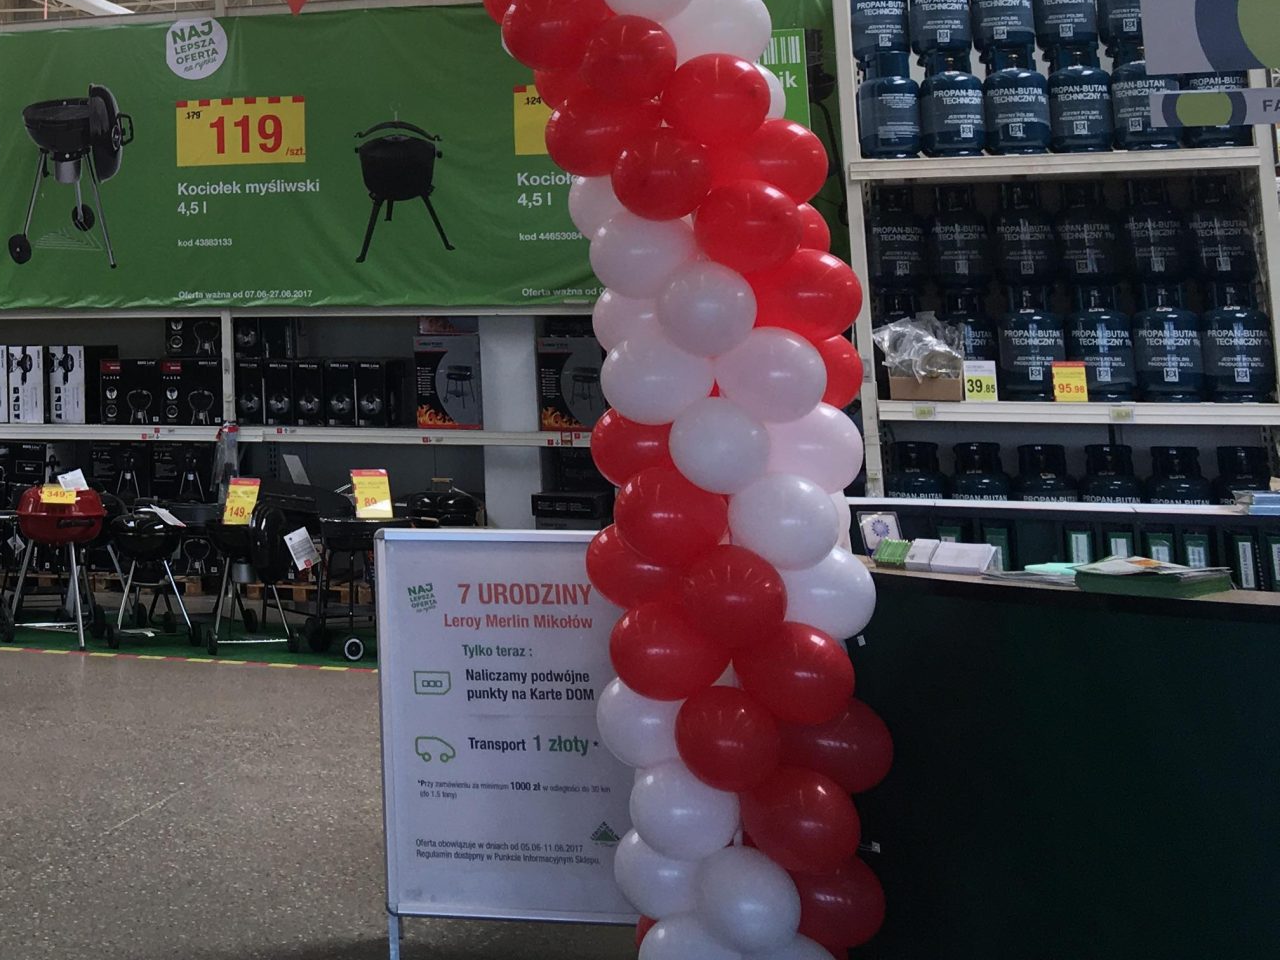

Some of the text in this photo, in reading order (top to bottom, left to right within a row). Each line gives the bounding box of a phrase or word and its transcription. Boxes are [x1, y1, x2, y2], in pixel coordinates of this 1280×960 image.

[922, 3, 962, 11] TECHNICZNY
[171, 20, 213, 45] NAJ
[174, 37, 216, 55] LEPSZA
[176, 47, 218, 65] OFERTA
[994, 96, 1035, 104] TECHNICZNY
[1058, 93, 1100, 101] TECHNICZNY
[185, 110, 201, 120] 179
[209, 114, 283, 154] 119
[177, 179, 320, 195] Kociołek myśliwski
[517, 192, 542, 208] 4,5
[177, 201, 199, 216] 4,5
[519, 232, 536, 241] kod
[178, 239, 193, 247] kod
[178, 290, 203, 299] Oferta
[205, 290, 231, 299] ważna
[233, 290, 243, 298] od
[522, 288, 550, 296] Oferta
[552, 288, 583, 296] ważna
[585, 287, 597, 296] od
[1004, 329, 1060, 338] PROPAN-BUTAN
[1072, 330, 1129, 338] PROPAN-BUTAN
[1138, 329, 1197, 337] PROPAN-BUTAN
[1079, 338, 1124, 346] TECHNICZNY
[1145, 338, 1192, 346] TECHNICZNY
[1215, 338, 1261, 346] TECHNICZNY
[966, 379, 996, 393] 39.85
[1058, 383, 1085, 393] 95.98
[407, 583, 433, 596] NAJ
[457, 583, 592, 605] 7 URODZINY
[444, 613, 592, 630] Leroy Merlin Mikołów
[462, 644, 525, 659] Tylko teraz
[465, 669, 590, 684] Naliczamy podwójne
[467, 687, 595, 701] punkty na Karte DOM
[468, 735, 589, 757] Transport 1 złoty
[510, 781, 531, 791] 1000
[533, 781, 541, 791] zł
[416, 839, 437, 848] Oferta
[438, 840, 476, 851] obowiązuje
[486, 842, 508, 850] dniach
[510, 842, 519, 851] od
[416, 850, 452, 860] Regulamin
[454, 852, 484, 862] dostępny
[494, 852, 520, 862] Punkcie
[523, 853, 573, 865] Informacyjnym
